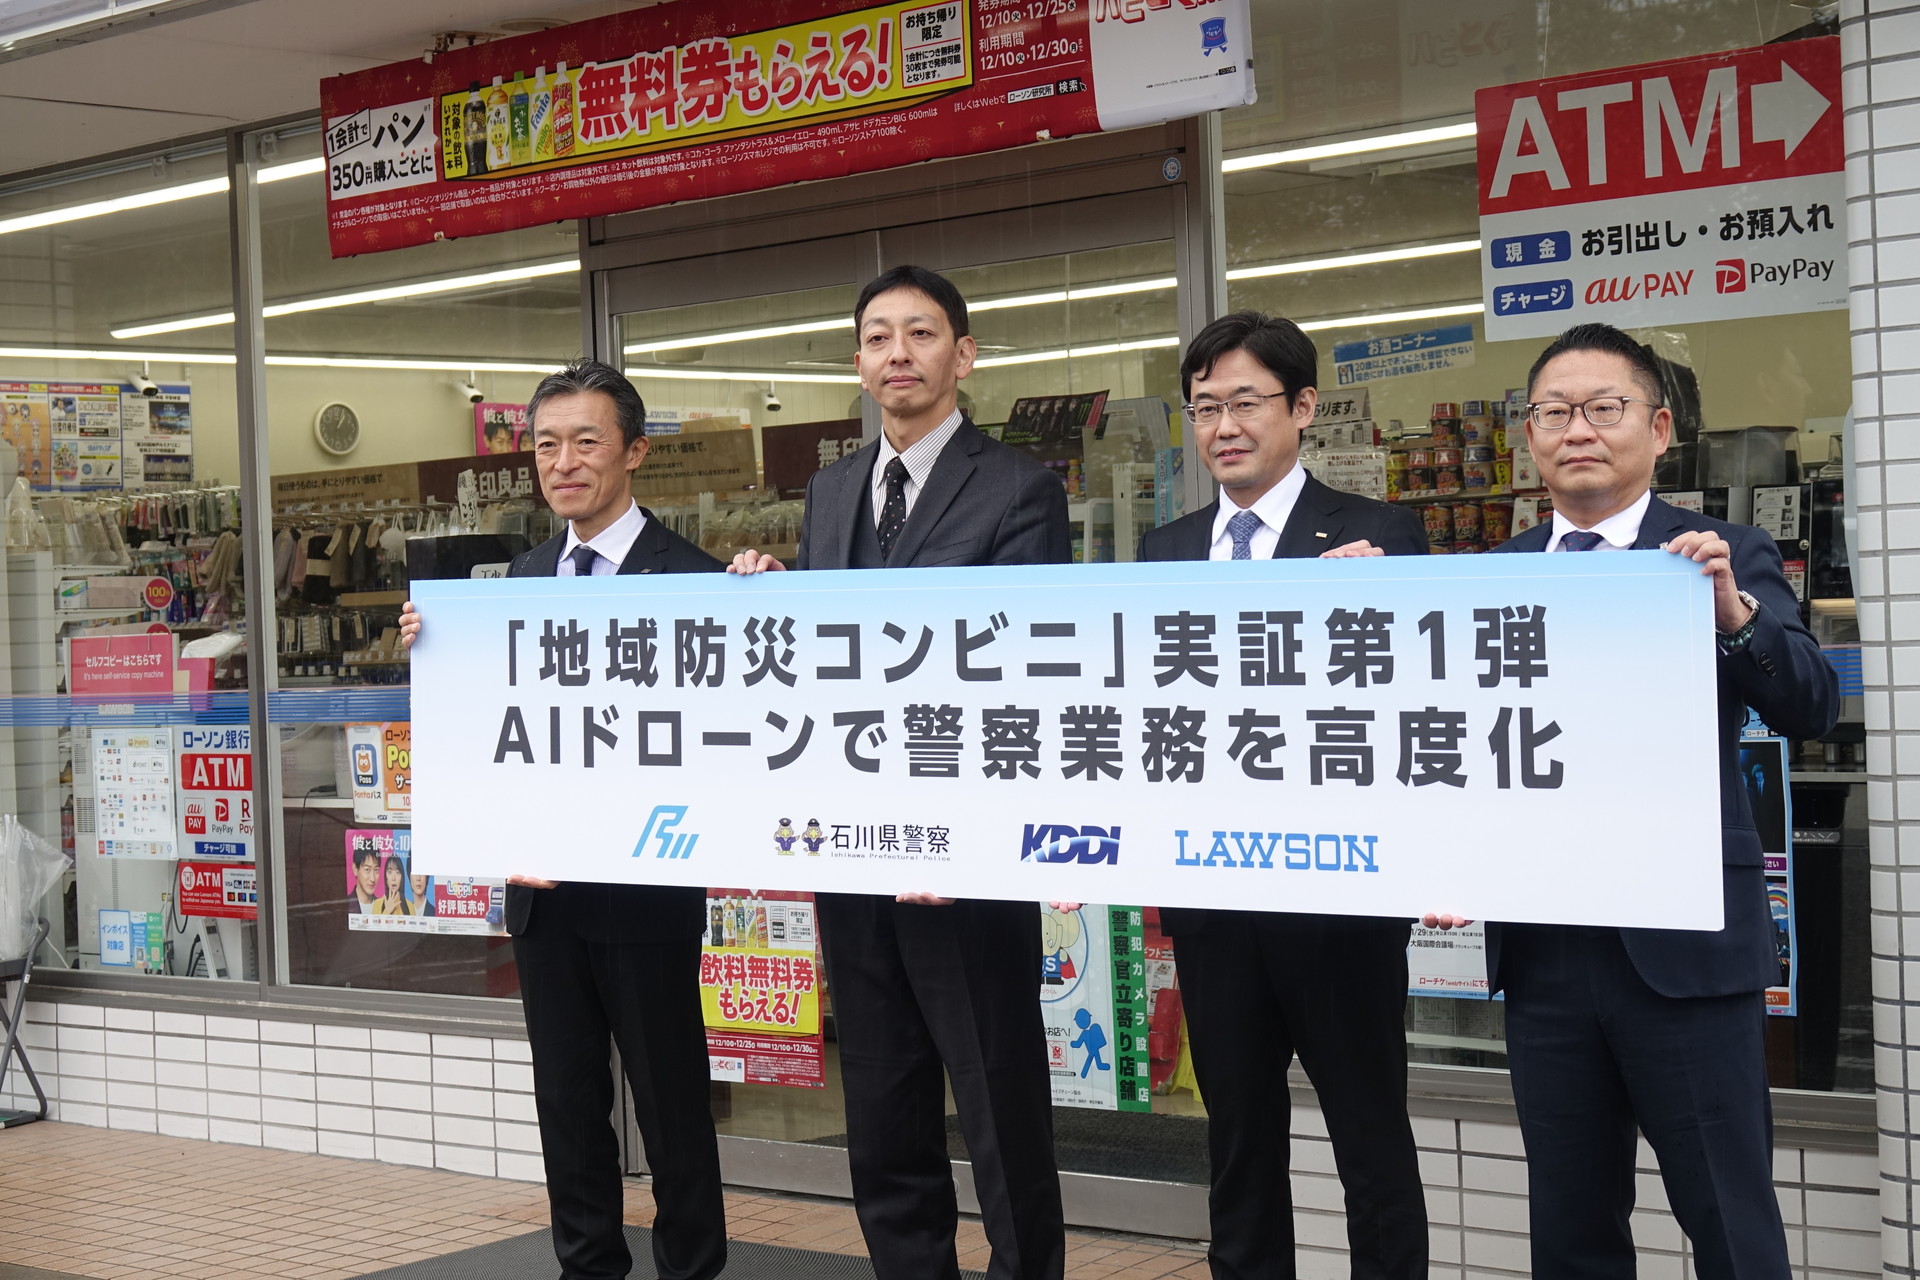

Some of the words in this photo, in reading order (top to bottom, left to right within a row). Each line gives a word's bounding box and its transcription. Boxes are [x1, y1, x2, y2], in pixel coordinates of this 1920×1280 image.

[905, 6, 957, 28] お持ち帰り
[921, 25, 943, 41] 限定
[978, 32, 1025, 52] 利用期間
[905, 44, 961, 62] 1会計につき無料券
[905, 54, 962, 72] 30枚まで発券可能
[578, 21, 890, 140] 無料券もらえる!
[906, 71, 942, 83] となります。
[954, 95, 1006, 112] 詳しくはWebで
[1009, 84, 1054, 101] ローソン研究所
[1058, 79, 1079, 94] 検索
[530, 93, 550, 130] Fanta
[328, 120, 368, 153] 1会計で
[371, 112, 425, 149] パン
[443, 105, 453, 170] いずれか一本
[452, 102, 463, 170] 対象の飲料
[1488, 65, 1742, 199] ATM
[1504, 237, 1557, 263] 現金
[1580, 203, 1835, 258] お引出し・お預入れ
[1583, 275, 1643, 306] au
[1643, 269, 1694, 299] PAY
[1749, 258, 1835, 292] PayPay
[1500, 285, 1568, 311] チャージ
[1367, 333, 1437, 356] お酒コーナー
[85, 653, 162, 668] セルフコピーはこちらです
[508, 604, 1550, 689] 「地域防災コンビニ」実証第1弾
[103, 671, 130, 680] self-service
[131, 672, 143, 681] copy
[143, 671, 164, 679] machine
[182, 730, 250, 749] ローソン銀行
[493, 703, 1565, 790] AIドローンで警察業務を高度化
[191, 757, 245, 787] ATM
[359, 775, 373, 785] Pass
[187, 803, 203, 815] au
[354, 790, 382, 800] Pontaパス
[188, 817, 203, 829] PAY
[211, 823, 234, 835] PayPay
[239, 823, 254, 836] Pay
[830, 822, 950, 855] 石川県警察
[203, 843, 237, 854] チャージ可能
[830, 851, 866, 859] Ishikawa
[869, 852, 919, 861] Prefectural
[923, 854, 951, 862] Police
[1020, 823, 1122, 866] KDDI
[1174, 829, 1380, 873] LAWSON
[195, 871, 221, 888] ATM
[437, 899, 486, 916] 好評販売中
[107, 940, 125, 951] 対象店
[700, 952, 815, 992] 飲料無料券
[718, 987, 803, 1027] もらえる!
[1111, 910, 1137, 1101] 警察官立寄り店舗
[1129, 910, 1150, 1103] 防犯カメラ設置店
